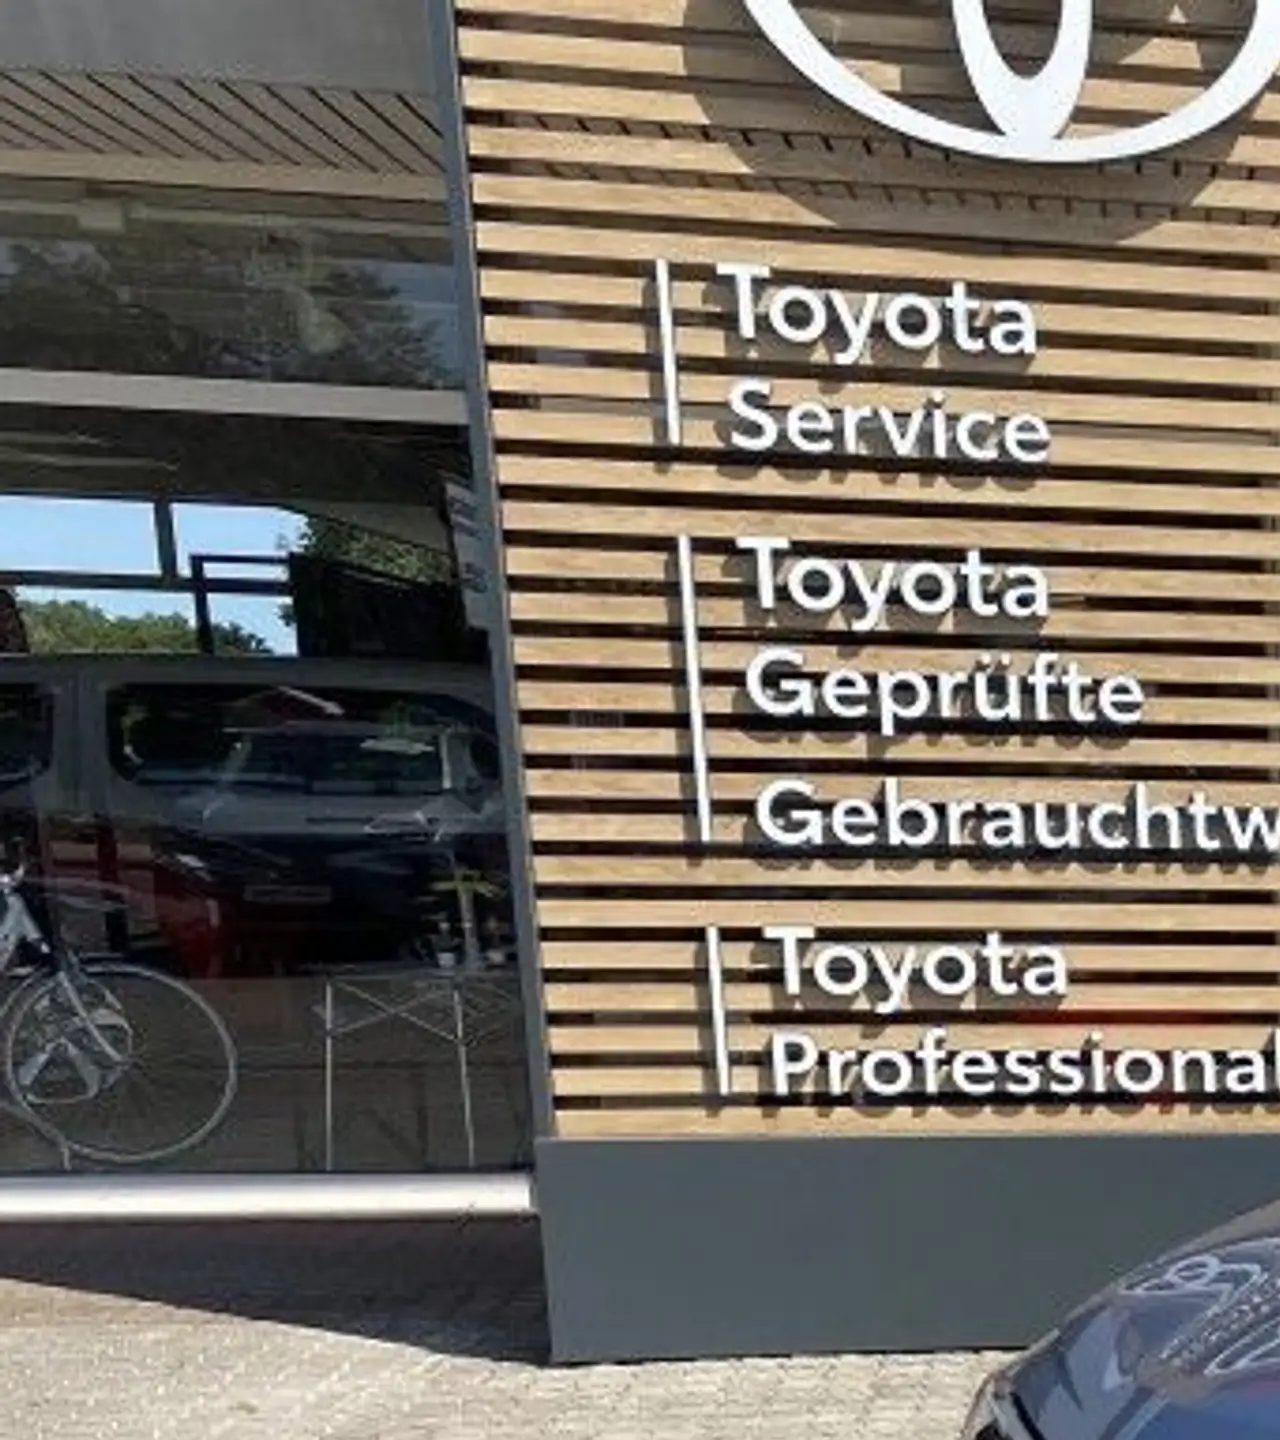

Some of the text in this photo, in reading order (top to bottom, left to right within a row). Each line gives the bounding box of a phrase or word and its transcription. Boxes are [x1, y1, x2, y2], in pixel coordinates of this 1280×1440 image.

[716, 262, 1037, 365] Toyota
[728, 378, 1052, 463] Service
[736, 536, 1050, 631] Toyota
[744, 646, 1145, 735] Geprüfte
[763, 926, 1069, 1012] Toyota
